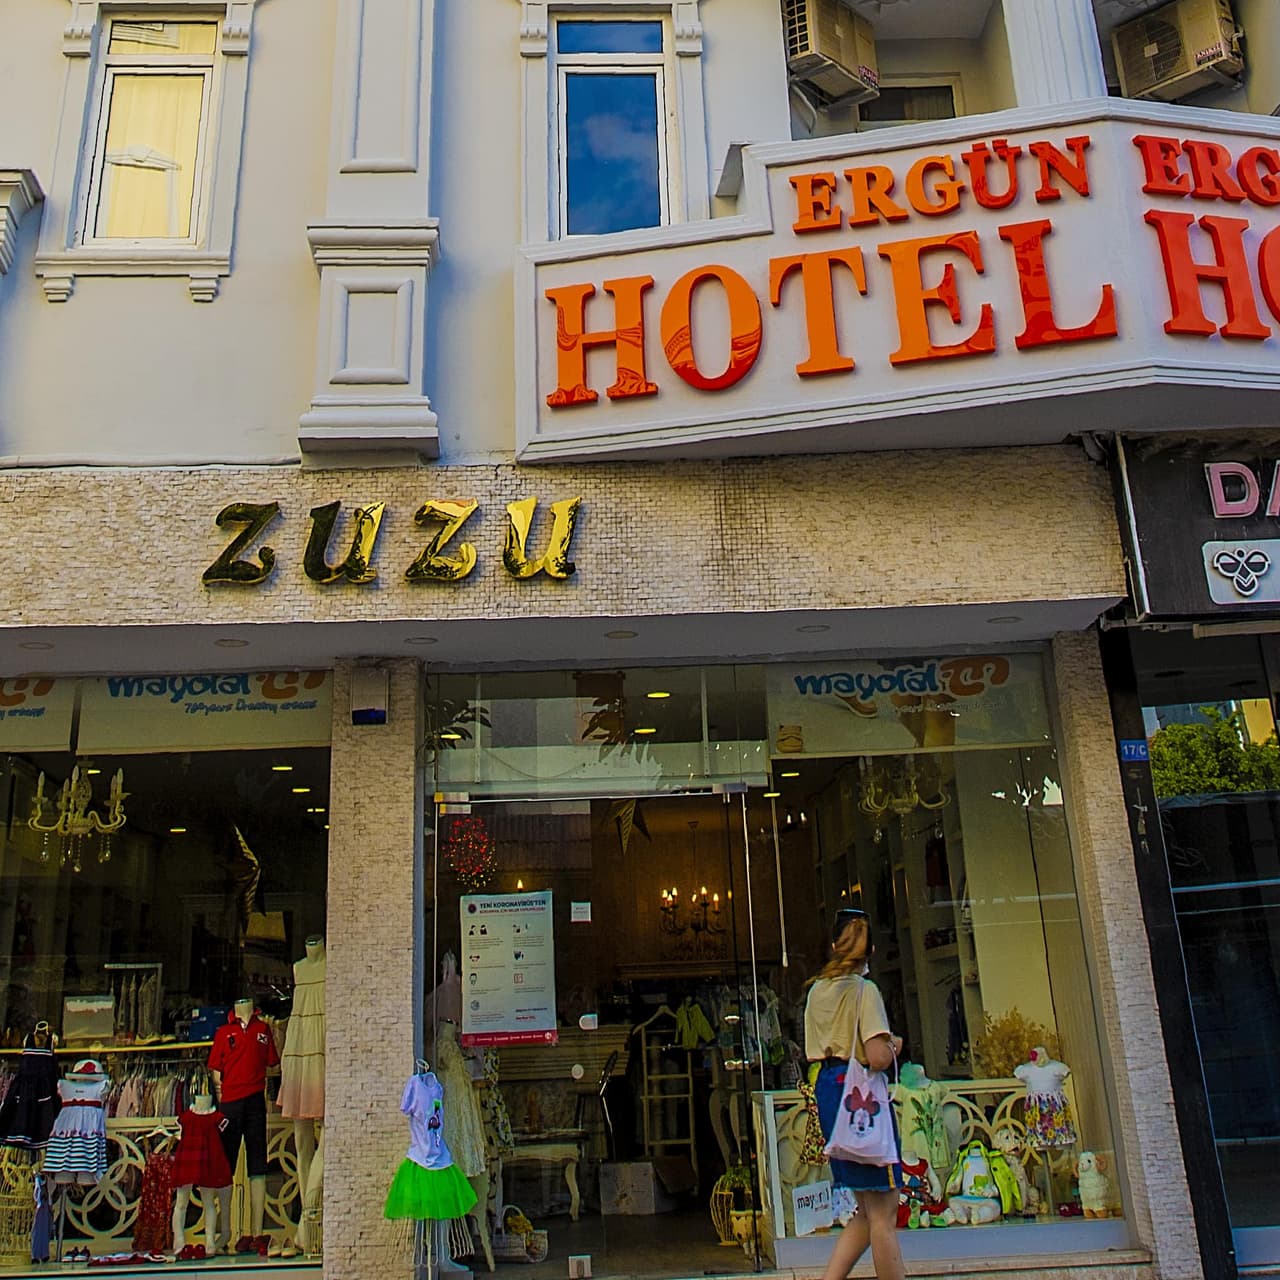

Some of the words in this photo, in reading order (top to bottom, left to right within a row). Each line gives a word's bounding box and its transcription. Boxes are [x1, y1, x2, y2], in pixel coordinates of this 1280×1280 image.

[789, 136, 1091, 234] ERGÜN
[545, 220, 1118, 408] HOTEL
[794, 663, 940, 700] mayoral
[797, 1187, 830, 1209] mayrl
